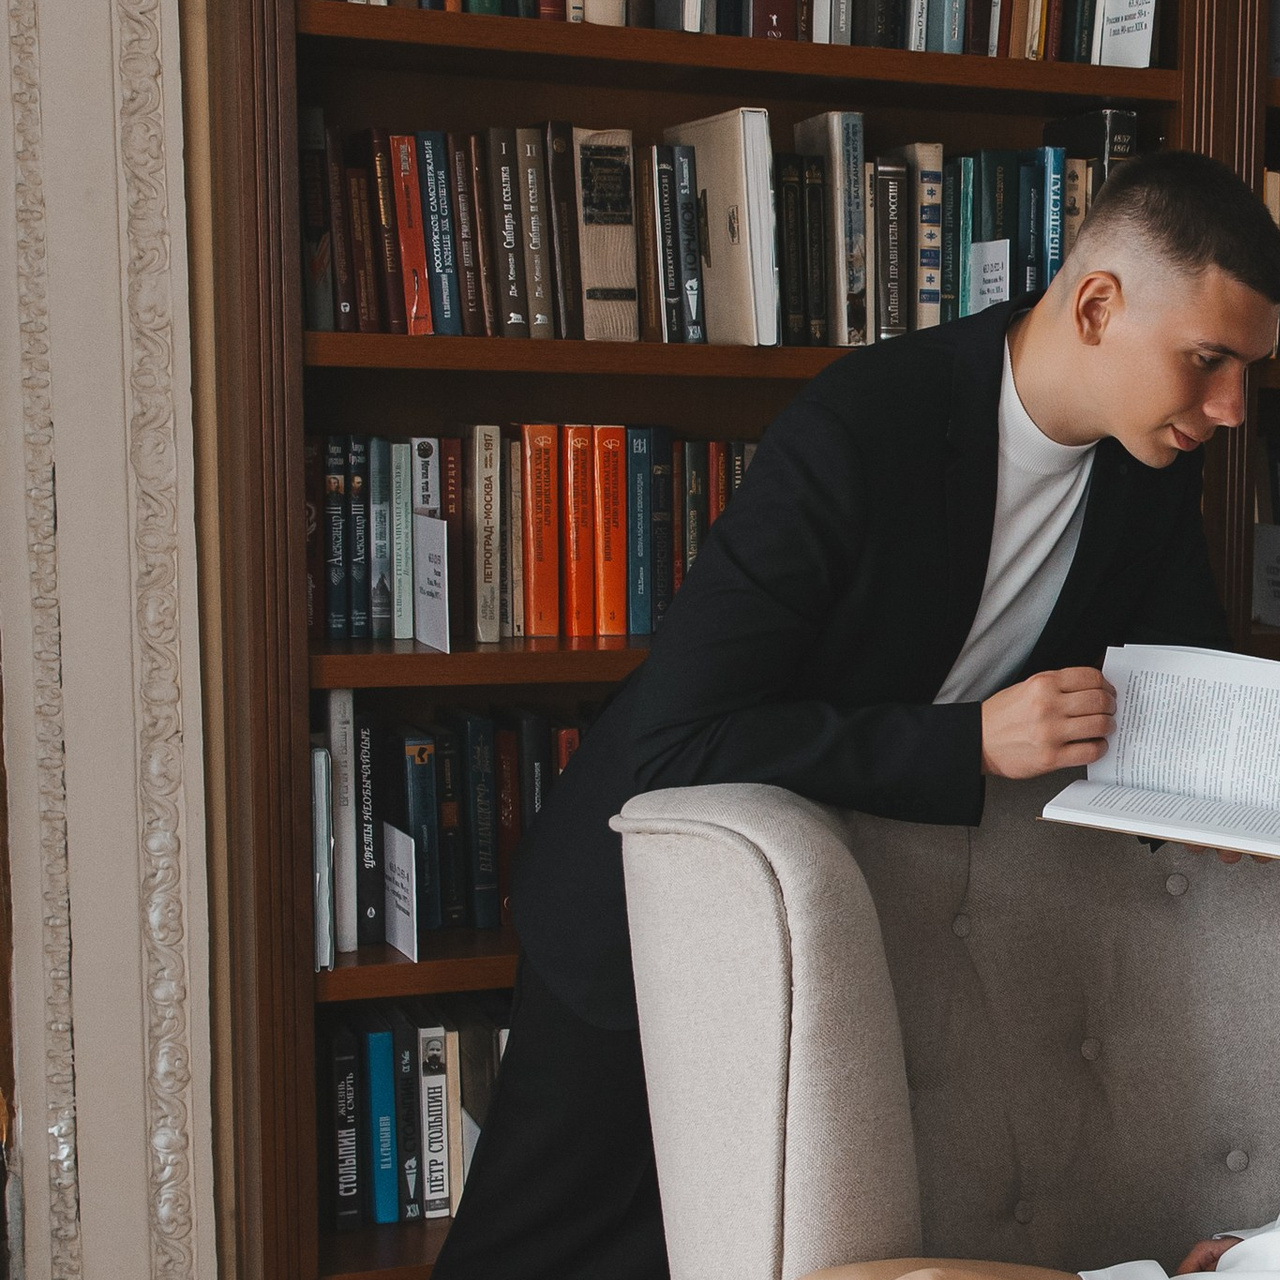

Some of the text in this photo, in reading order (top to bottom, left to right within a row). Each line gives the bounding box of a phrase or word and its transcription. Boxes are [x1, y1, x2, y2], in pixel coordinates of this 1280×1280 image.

[436, 170, 448, 216] СТОЛЕТИЯ
[499, 166, 511, 202] ссылка
[527, 168, 538, 204] ссылка
[851, 154, 861, 200] БАЛКАНАХ
[423, 139, 444, 273] РОССИЙСКОЕ САМОДЕРЖАВИЕ
[439, 217, 449, 232] XIX
[502, 203, 511, 211] и
[944, 176, 954, 228] ПРОШЛОМ
[1048, 173, 1062, 261] ПЬЕДЕСТАЛ
[441, 234, 453, 267] КОНЦЕ
[500, 212, 516, 249] Сибирь
[528, 214, 543, 250] Сибирь
[684, 201, 698, 272] ГОРЧАКОВ
[886, 181, 899, 324] ТАЙНЫЙ ПРАВИТЕЛЬ РОССИИ
[666, 248, 675, 291] ПЕРЕВОРОТ
[944, 232, 954, 281] ДАЛЕКОМ
[483, 432, 494, 451] 1917
[327, 516, 344, 567] Александр
[351, 503, 365, 565] Александр III
[483, 475, 494, 584] ПЕТРОГРАД-МОСКВА
[359, 728, 376, 869] ЦВЕТЫ НЕОБЫЧАЙНЫЕ
[338, 1080, 346, 1117] ЖИЗНЬ
[346, 1072, 355, 1111] СМЕРТЬ
[337, 1128, 357, 1197] СТОЛЫПИН
[427, 1084, 445, 1195] ПЁТР СТОЛЫПИН
